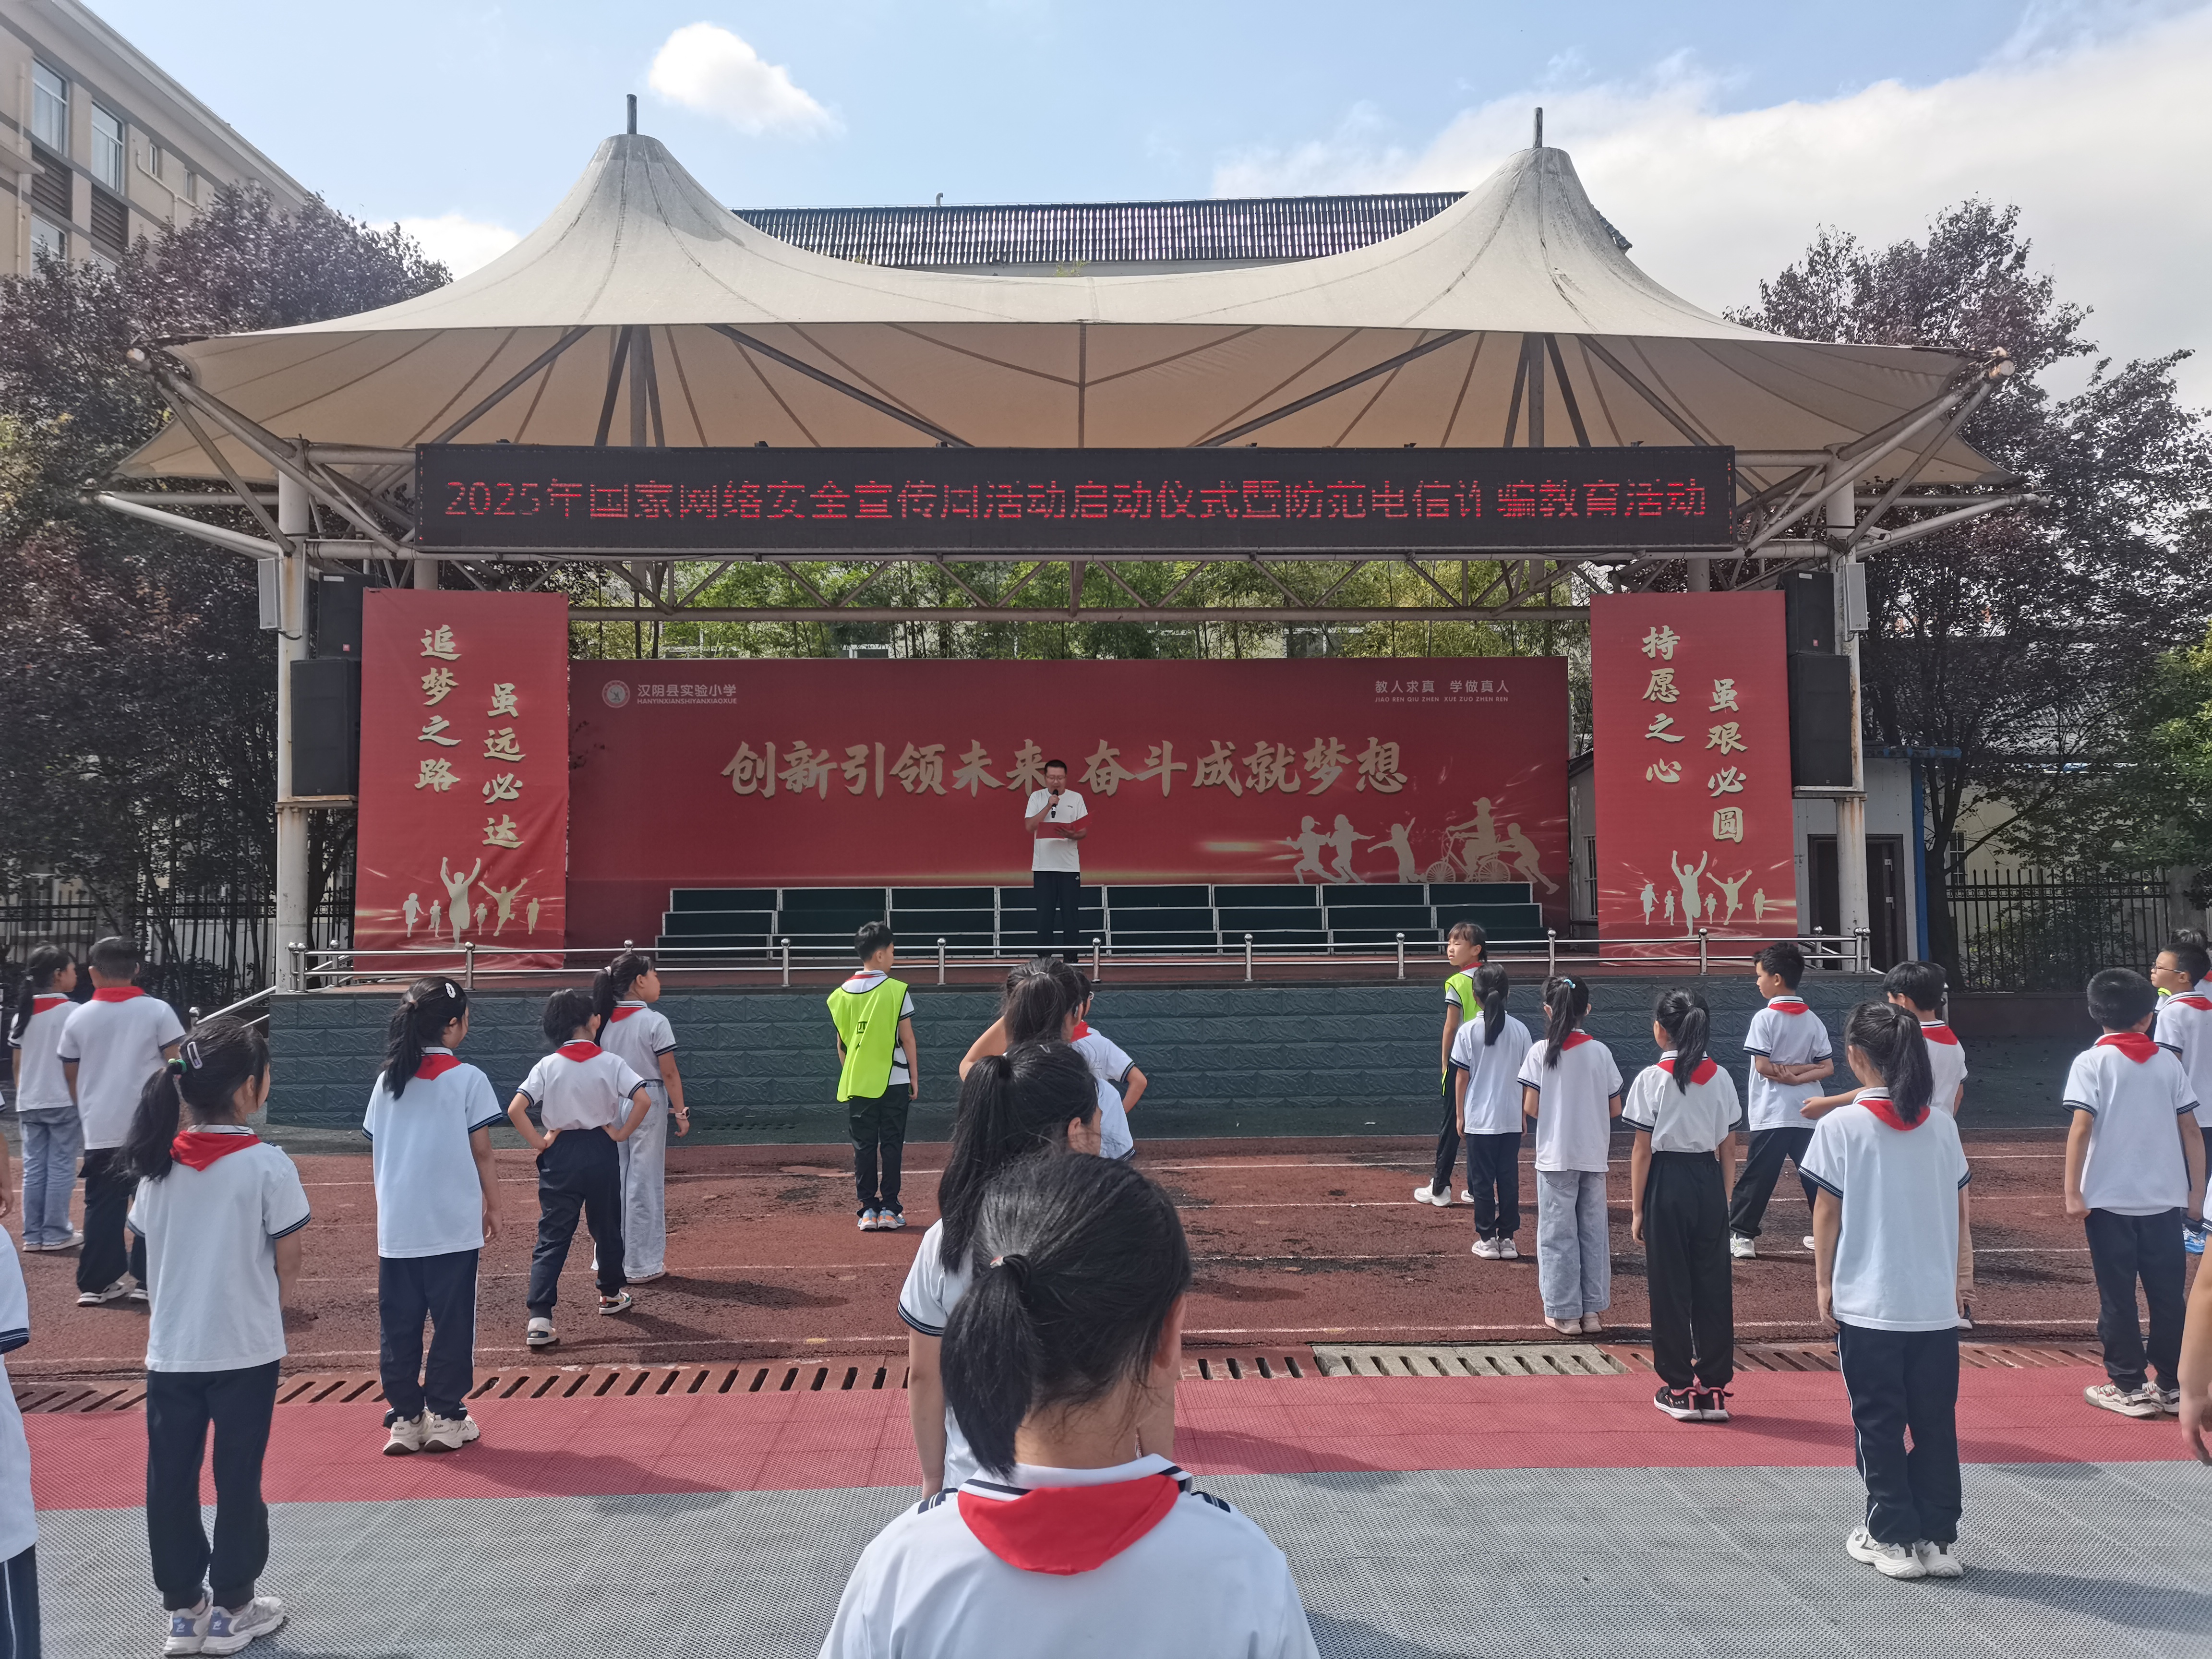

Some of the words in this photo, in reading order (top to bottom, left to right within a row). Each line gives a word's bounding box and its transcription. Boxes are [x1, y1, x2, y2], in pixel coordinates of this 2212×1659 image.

[415, 625, 462, 792] 追梦之路
[637, 684, 736, 697] 汉阴县实验小学
[1375, 680, 1434, 693] 教人求真
[1450, 680, 1509, 693] 学做真人
[1642, 625, 1685, 782] 持愿之心
[1705, 678, 1748, 842] 虽艰必圆
[482, 683, 526, 848] 虽远必达
[721, 739, 1047, 799] 创新引领未来
[1078, 736, 1407, 797] 奋斗成就梦想
